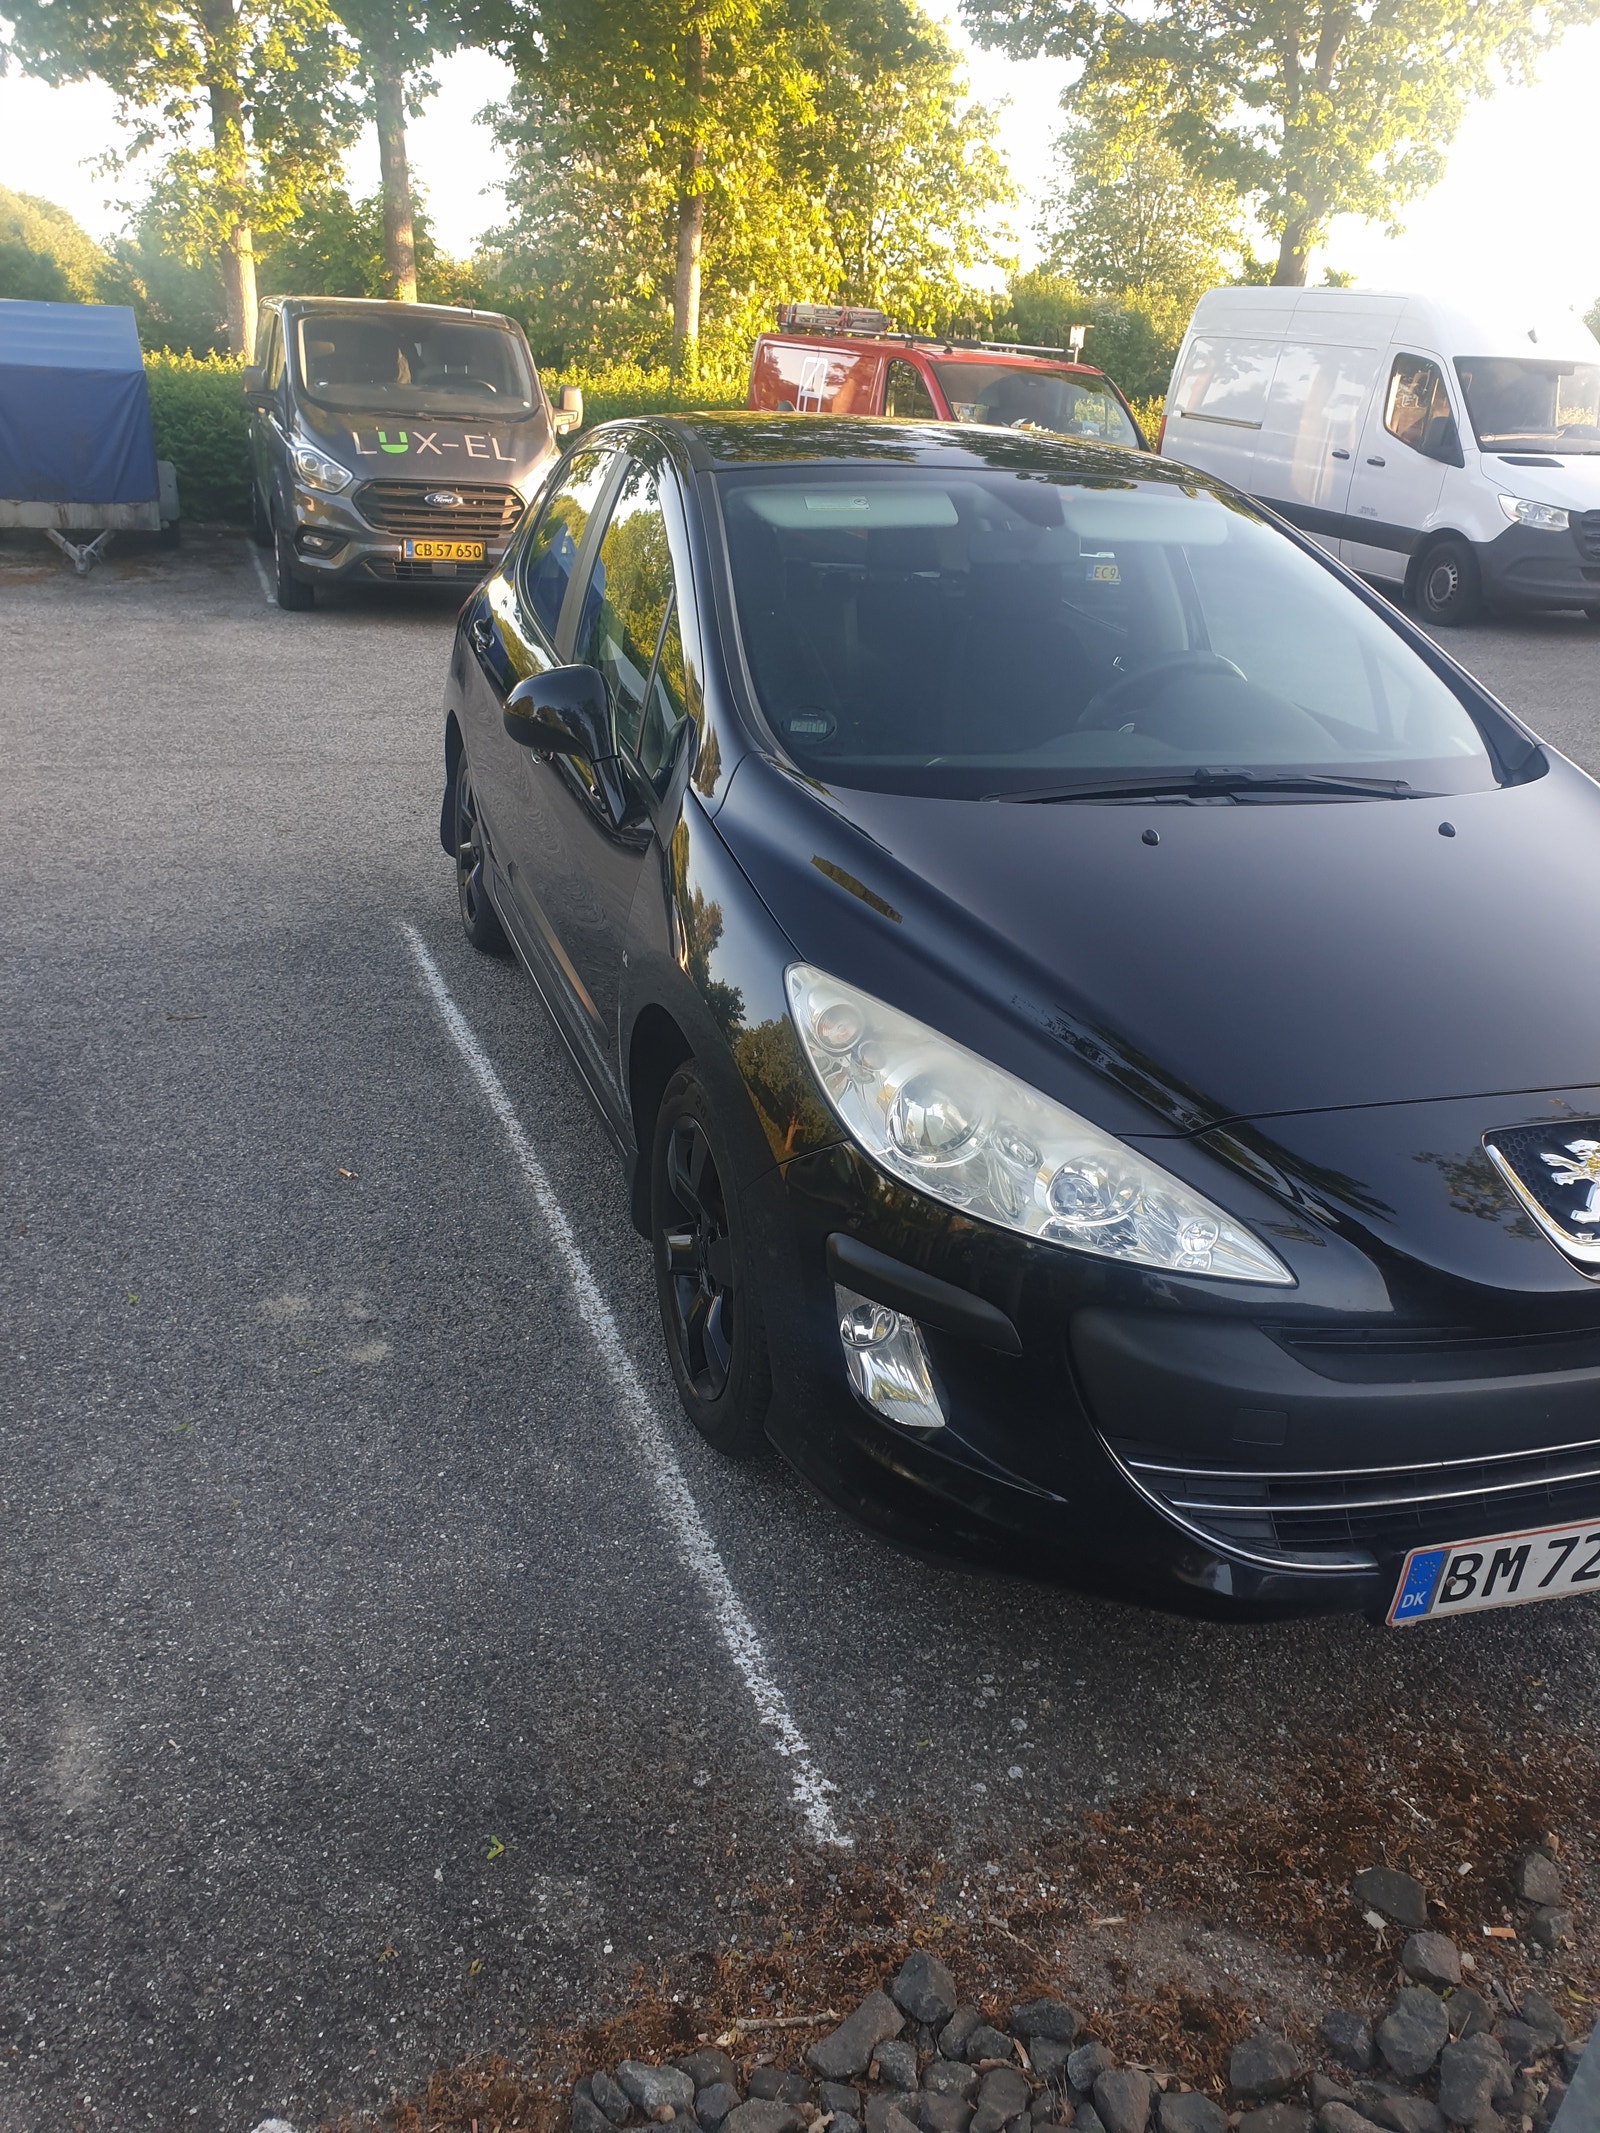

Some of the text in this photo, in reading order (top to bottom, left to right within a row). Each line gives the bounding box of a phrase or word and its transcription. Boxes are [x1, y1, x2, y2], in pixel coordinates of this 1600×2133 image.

[352, 431, 517, 462] LUX-EL
[433, 494, 454, 504] Ford
[414, 543, 433, 557] CB
[436, 544, 453, 558] 57
[456, 544, 482, 559] 650
[1438, 1532, 1600, 1604] BM 72
[1401, 1591, 1427, 1609] DK
